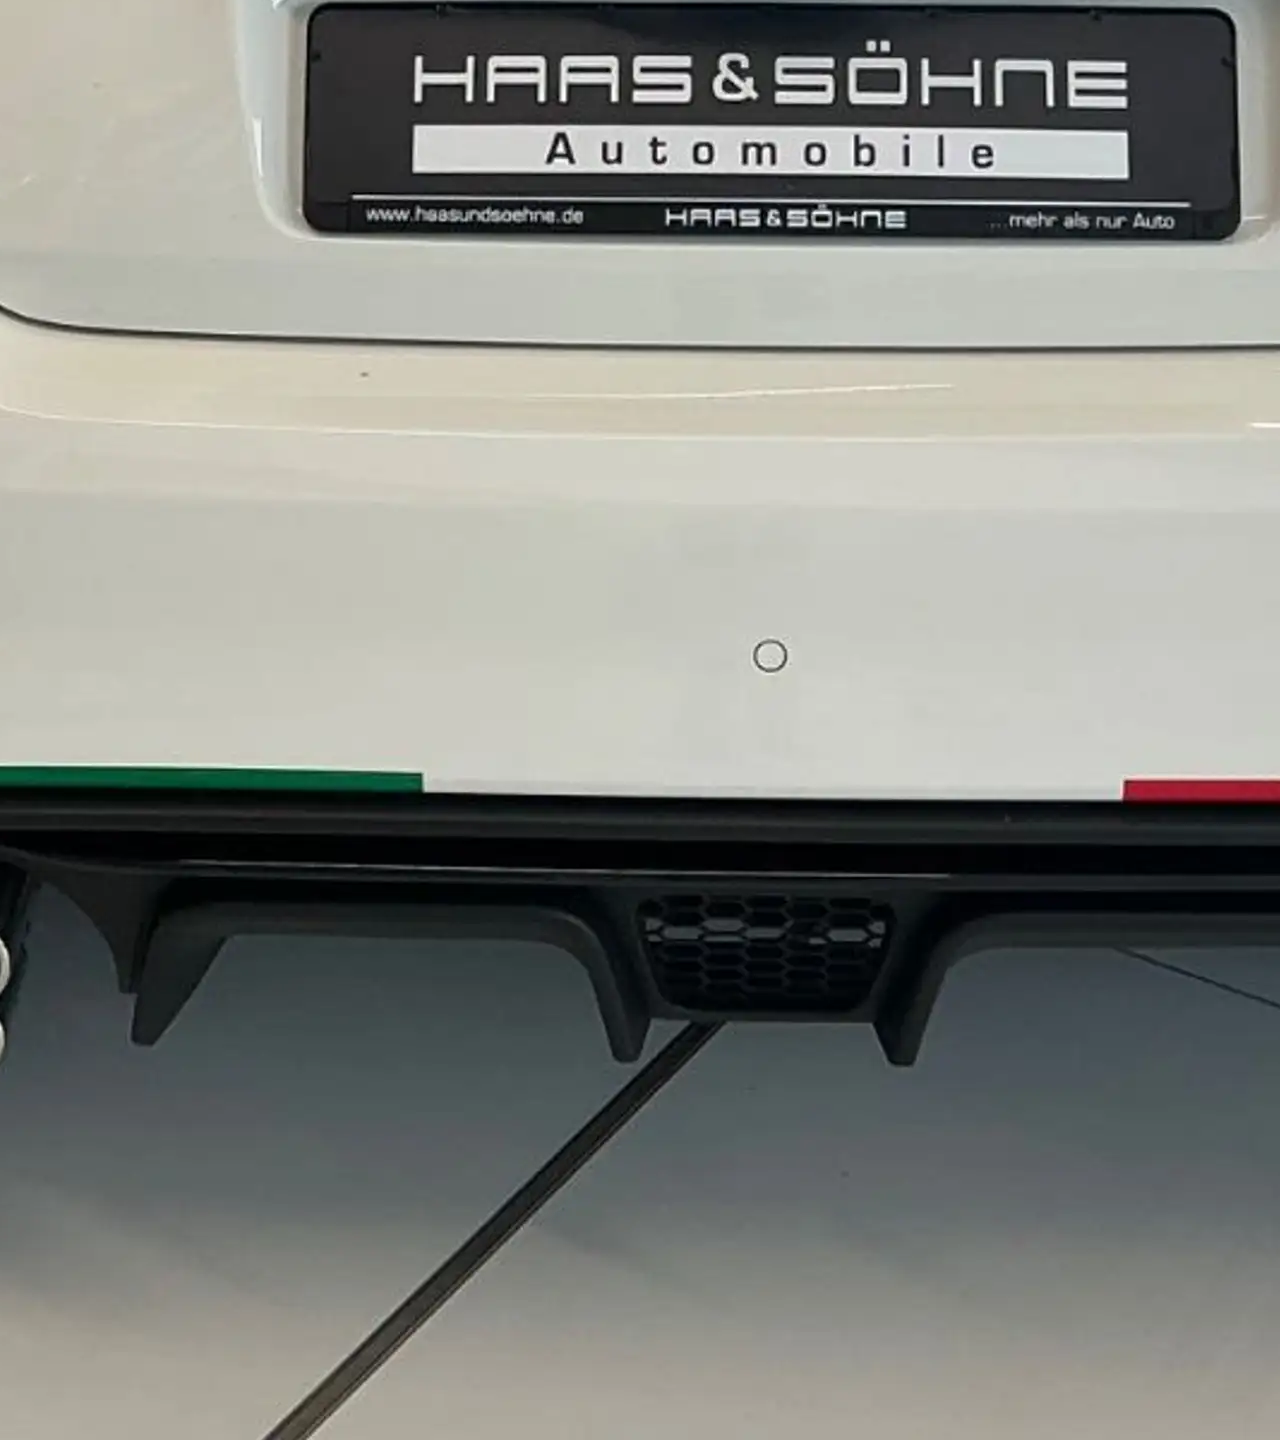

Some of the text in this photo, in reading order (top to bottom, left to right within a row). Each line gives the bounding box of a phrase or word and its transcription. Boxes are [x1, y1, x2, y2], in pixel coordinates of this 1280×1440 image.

[545, 131, 995, 169] Automobile
[365, 205, 584, 225] www.haasundsoehne.de
[1062, 210, 1090, 229] als
[1095, 215, 1127, 229] nur
[1132, 211, 1175, 230] Auto
